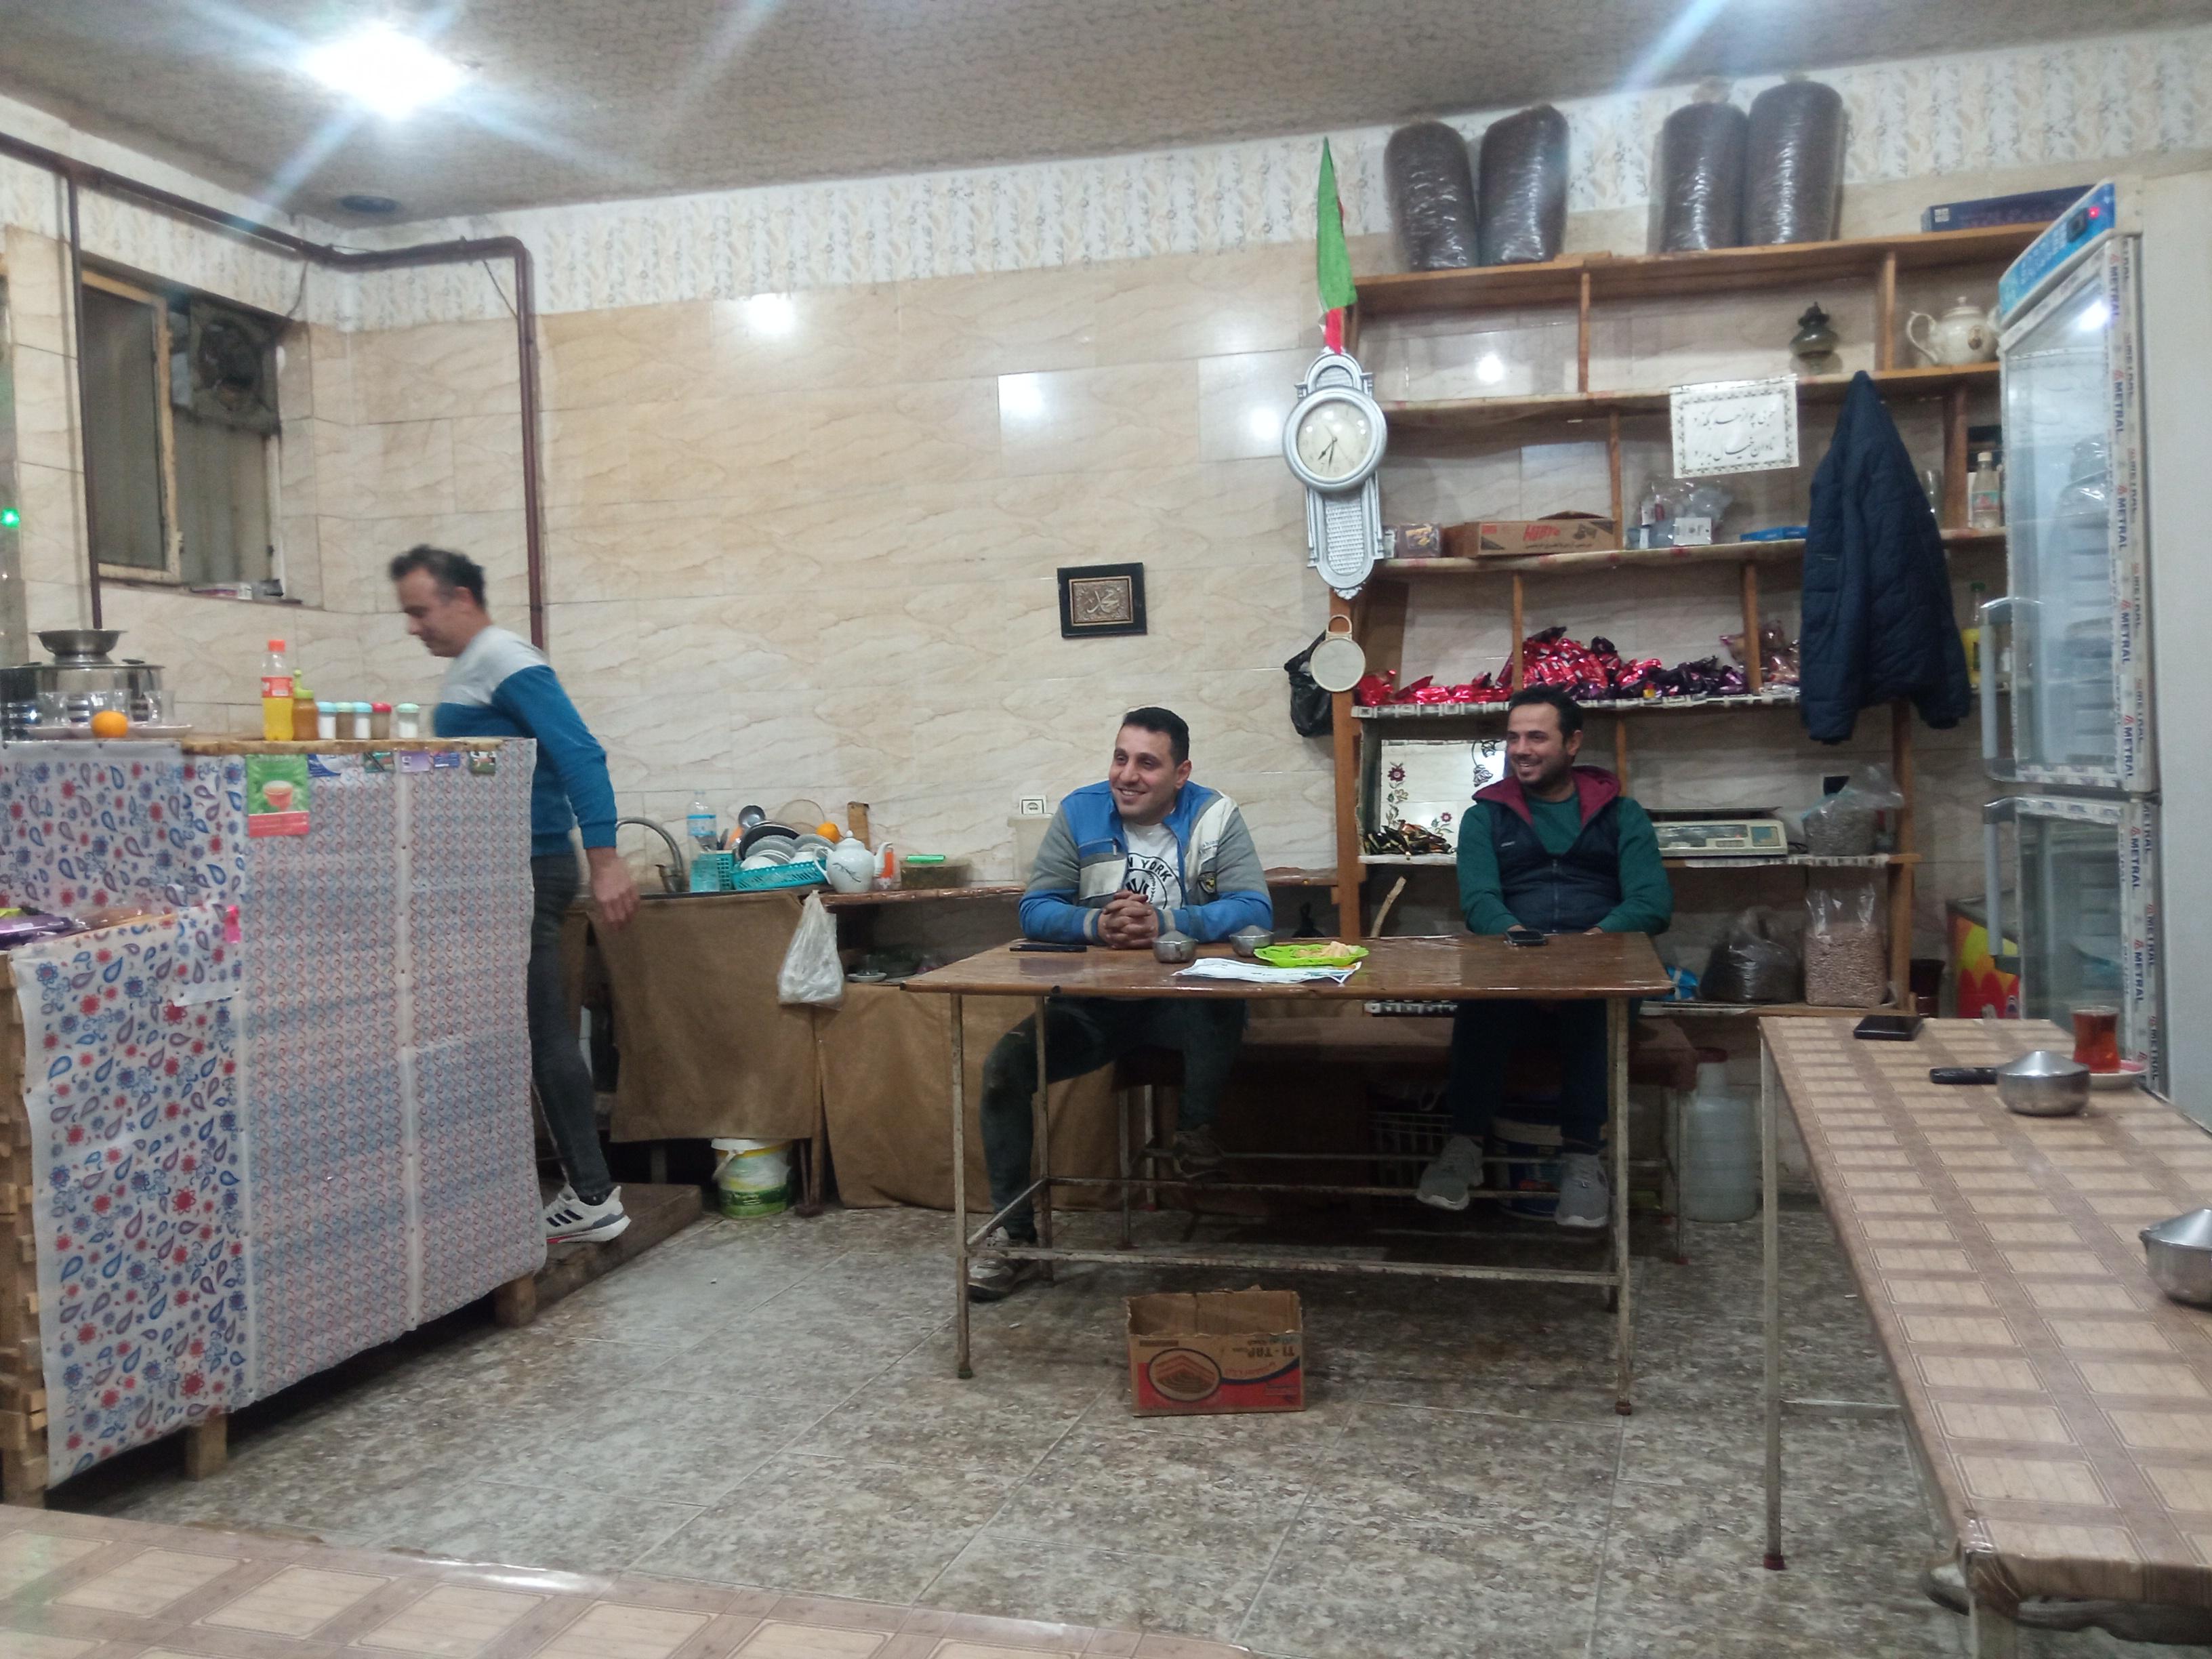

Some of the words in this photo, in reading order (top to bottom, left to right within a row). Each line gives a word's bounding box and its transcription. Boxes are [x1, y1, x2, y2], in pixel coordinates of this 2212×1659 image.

[2110, 266, 2120, 316] METRAL
[2114, 381, 2124, 432] METRAL
[2118, 497, 2127, 549] METRAL
[2121, 612, 2131, 663] METRAL
[2124, 726, 2133, 777] METRAL
[1141, 859, 1172, 882] YORK
[2131, 838, 2140, 887] METRAL
[2135, 951, 2144, 1001] METRAL
